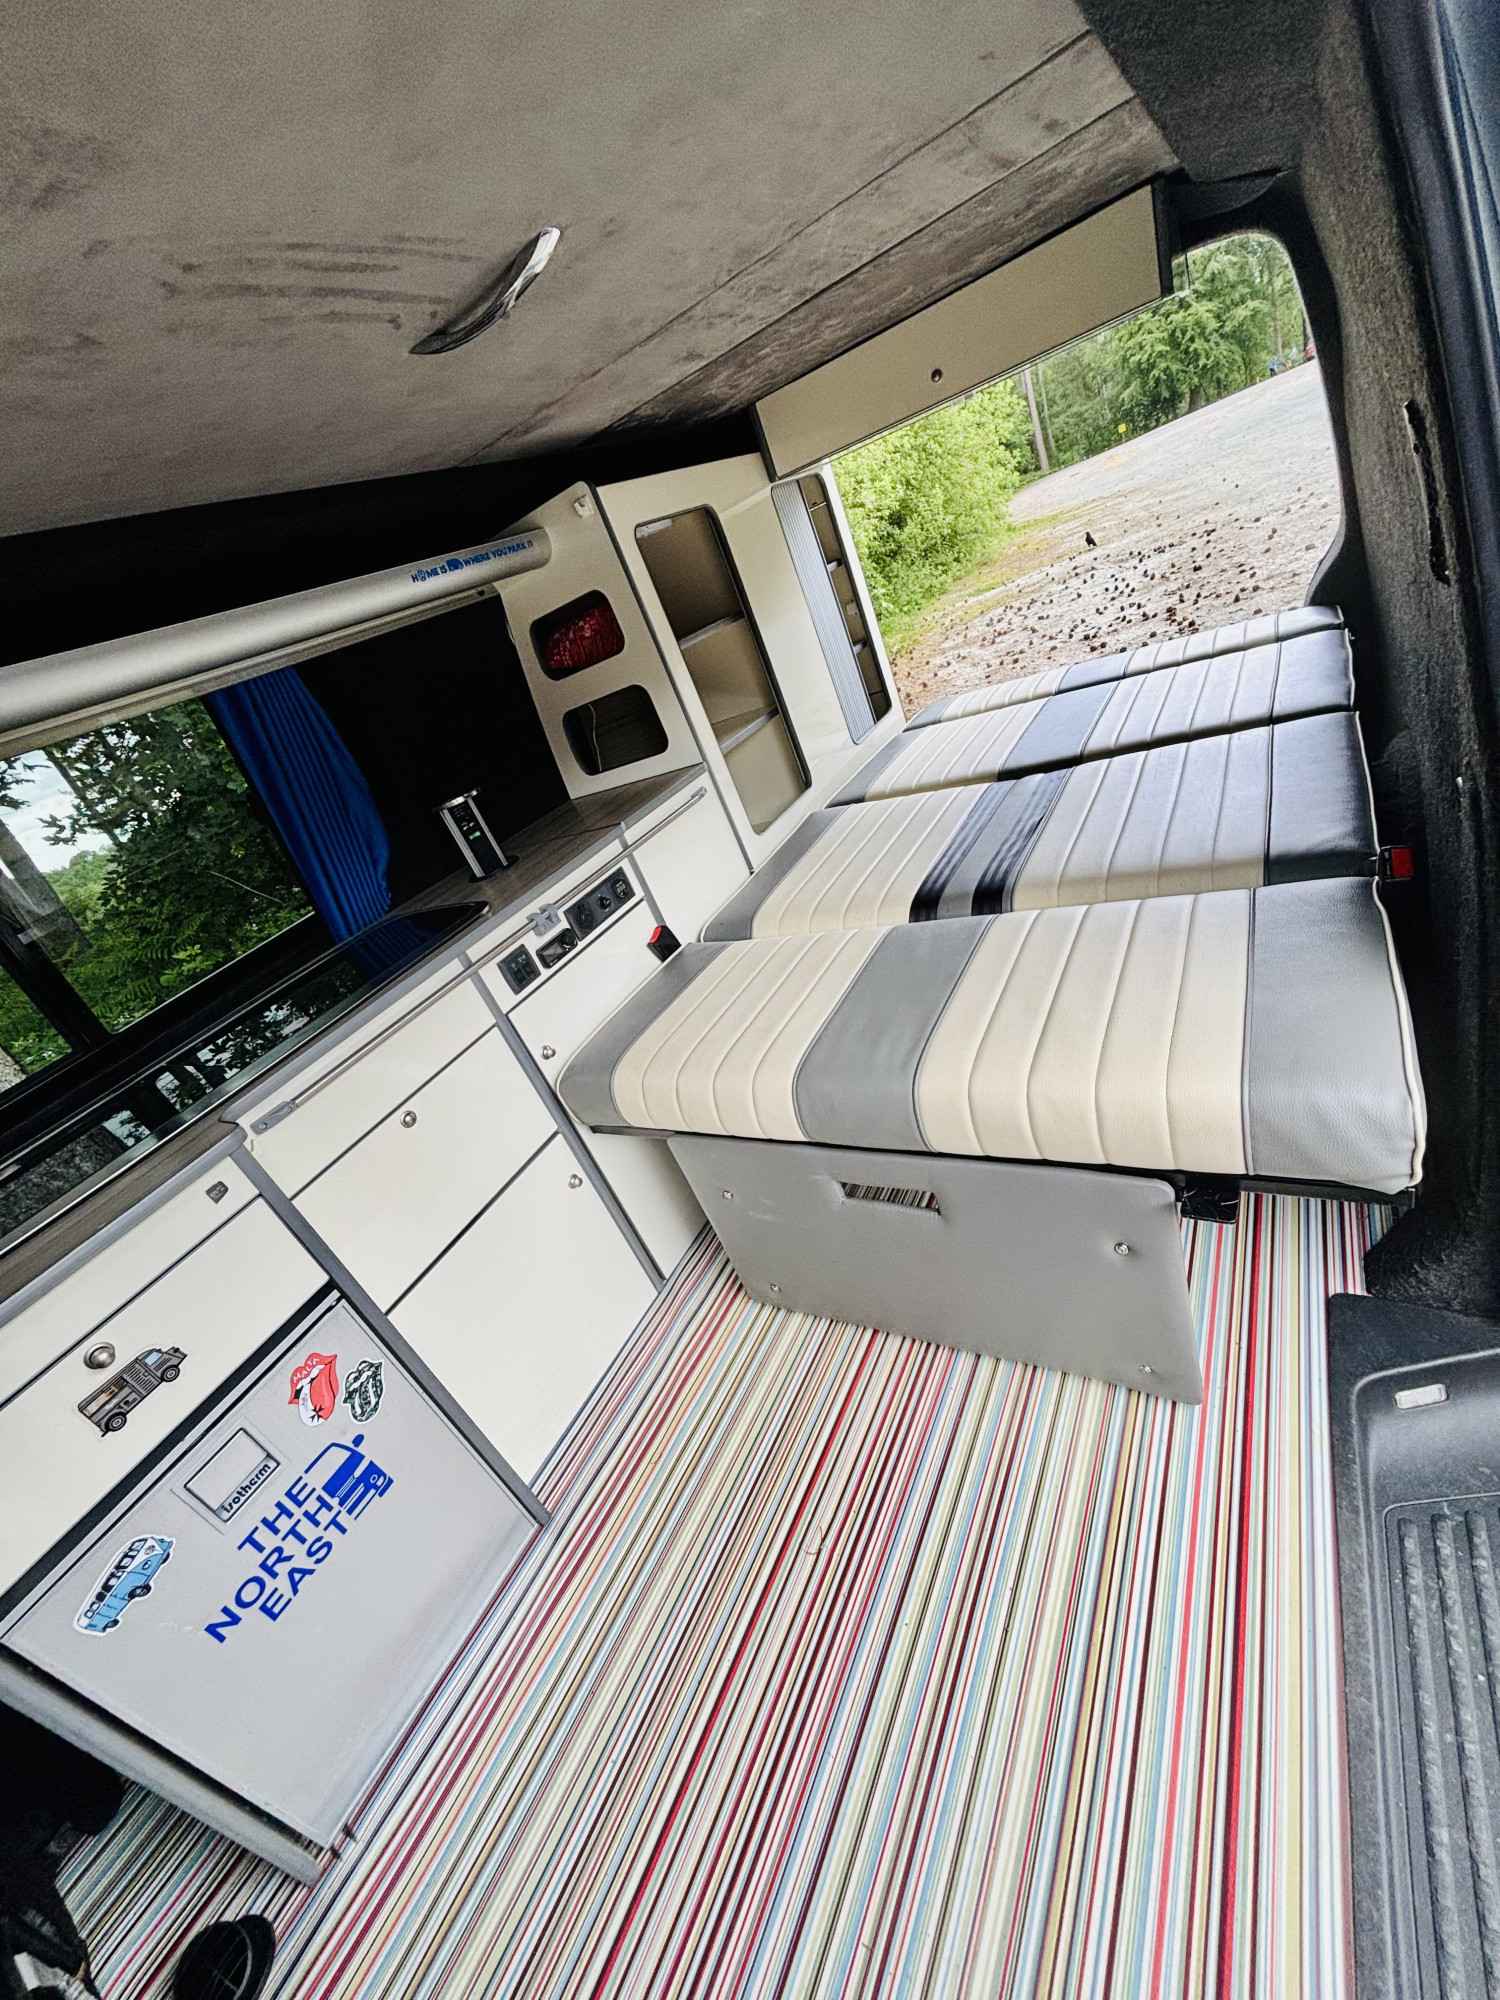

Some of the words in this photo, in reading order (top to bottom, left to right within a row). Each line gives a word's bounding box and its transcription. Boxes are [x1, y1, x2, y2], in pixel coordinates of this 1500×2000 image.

[411, 567, 440, 583] HOME
[440, 565, 448, 574] IS
[463, 553, 490, 566] WHERE
[491, 547, 507, 558] YOU
[507, 542, 526, 553] PARK
[293, 1357, 320, 1383] MALTA
[223, 1463, 272, 1513] isotherm
[238, 1476, 316, 1554] THE
[204, 1494, 333, 1643] NORTH
[259, 1509, 349, 1622] EAST
